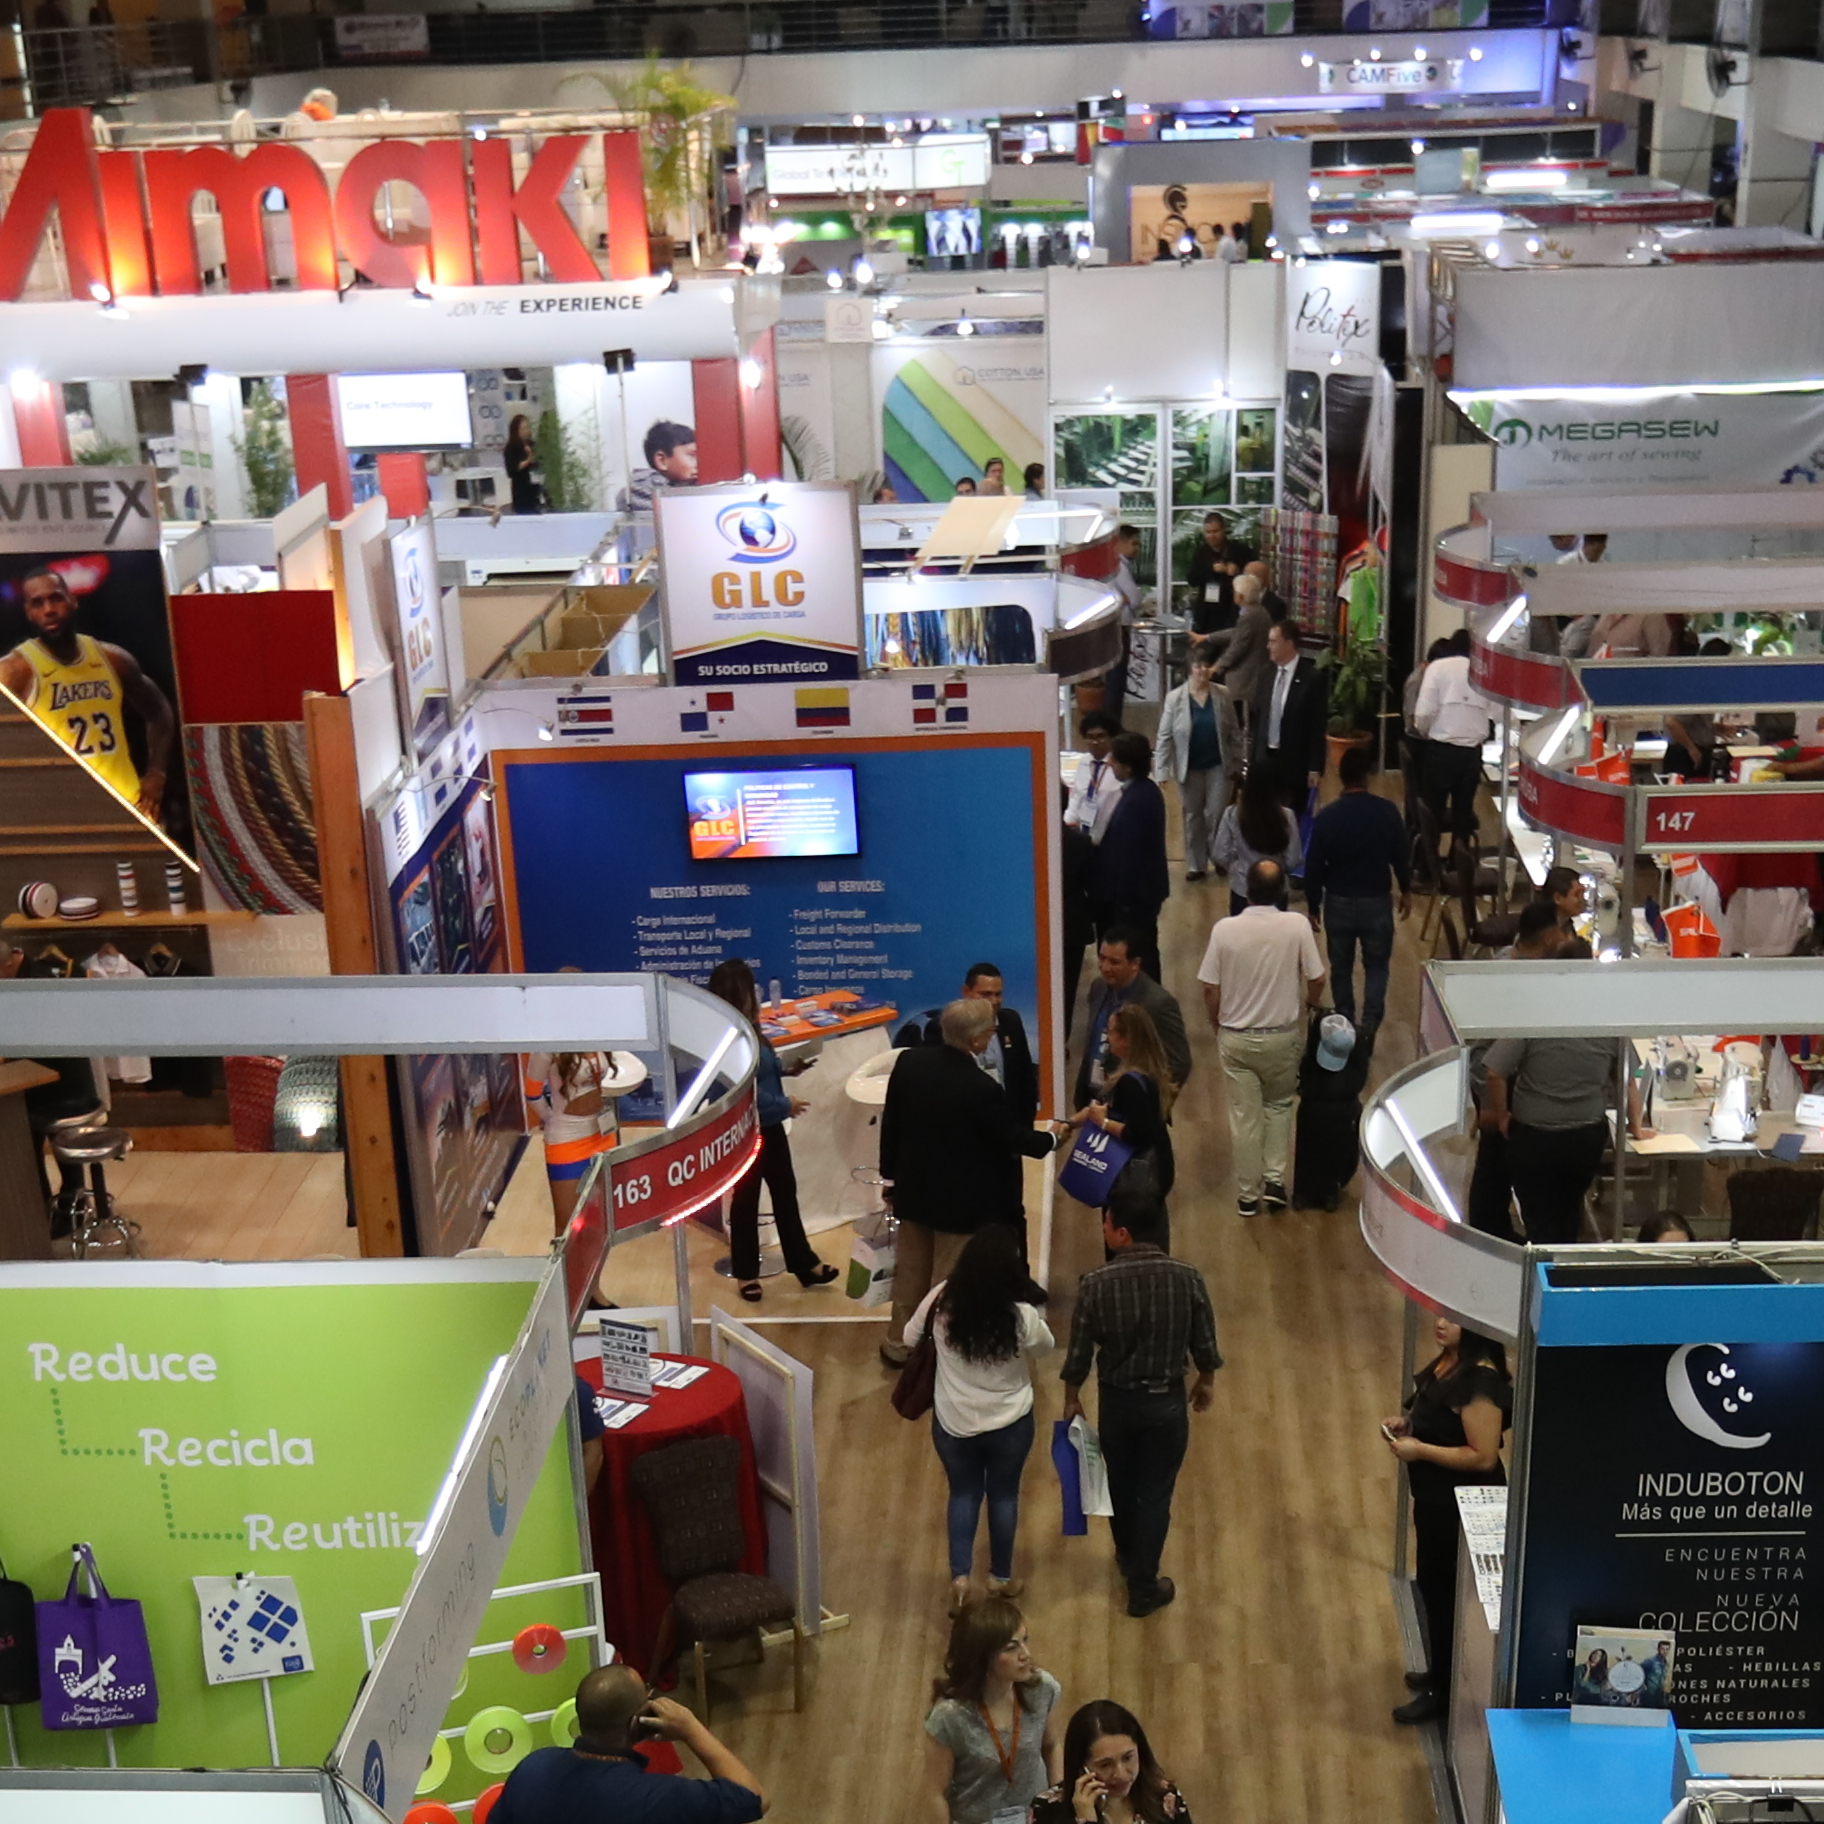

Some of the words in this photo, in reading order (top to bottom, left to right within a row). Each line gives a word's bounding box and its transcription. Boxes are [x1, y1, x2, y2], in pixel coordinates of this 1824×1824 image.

[1345, 63, 1423, 86] CAMFive
[519, 295, 644, 315] EXPERIENCE
[1537, 418, 1720, 441] MEGASEW
[1551, 448, 1584, 463] The
[1618, 446, 1638, 463] of
[1640, 447, 1703, 465] sewing
[711, 569, 806, 611] GLC
[698, 664, 714, 677] SU
[716, 663, 751, 676] SOCIO
[752, 659, 829, 676] ESTRATÉGICO
[49, 681, 114, 711] LAKERS
[68, 712, 117, 755] 23
[693, 819, 736, 837] GLC
[1655, 811, 1696, 832] 147
[650, 886, 699, 900] NUESTROS
[699, 884, 751, 898] SERVICIOS:
[817, 881, 836, 893] OUR
[838, 880, 886, 893] SERVICES:
[636, 915, 662, 928] Carga
[662, 913, 717, 926] Internacional
[638, 931, 683, 943] Transporte
[684, 929, 707, 940] Local
[715, 928, 752, 941] Regional
[639, 945, 677, 957] Servicios
[678, 945, 690, 956] de
[691, 944, 724, 956] Aduana
[640, 960, 702, 971] Administración
[1072, 1149, 1108, 1171] SEALAND
[613, 1175, 652, 1209] 163
[667, 1154, 696, 1187] QC
[27, 1342, 219, 1383] Reduce
[138, 1428, 316, 1467] Recicla
[1636, 1471, 1805, 1498] INDUBOTON
[1621, 1501, 1666, 1521] Más
[1670, 1505, 1709, 1524] que
[1714, 1504, 1739, 1521] un
[1745, 1500, 1813, 1521] detalle
[242, 1512, 422, 1552] Reutiliz
[1664, 1547, 1809, 1563] ENCUENTRA
[1694, 1566, 1805, 1582] NUESTRA
[1715, 1593, 1802, 1608] NUEVA
[1638, 1604, 1800, 1634] COLECCIÓN
[1676, 1644, 1766, 1657] POLIÉSTER
[1742, 1661, 1823, 1673] HEBILLAS
[1716, 1678, 1812, 1690] NATURALES
[1703, 1711, 1807, 1722] ACCESORIOS
